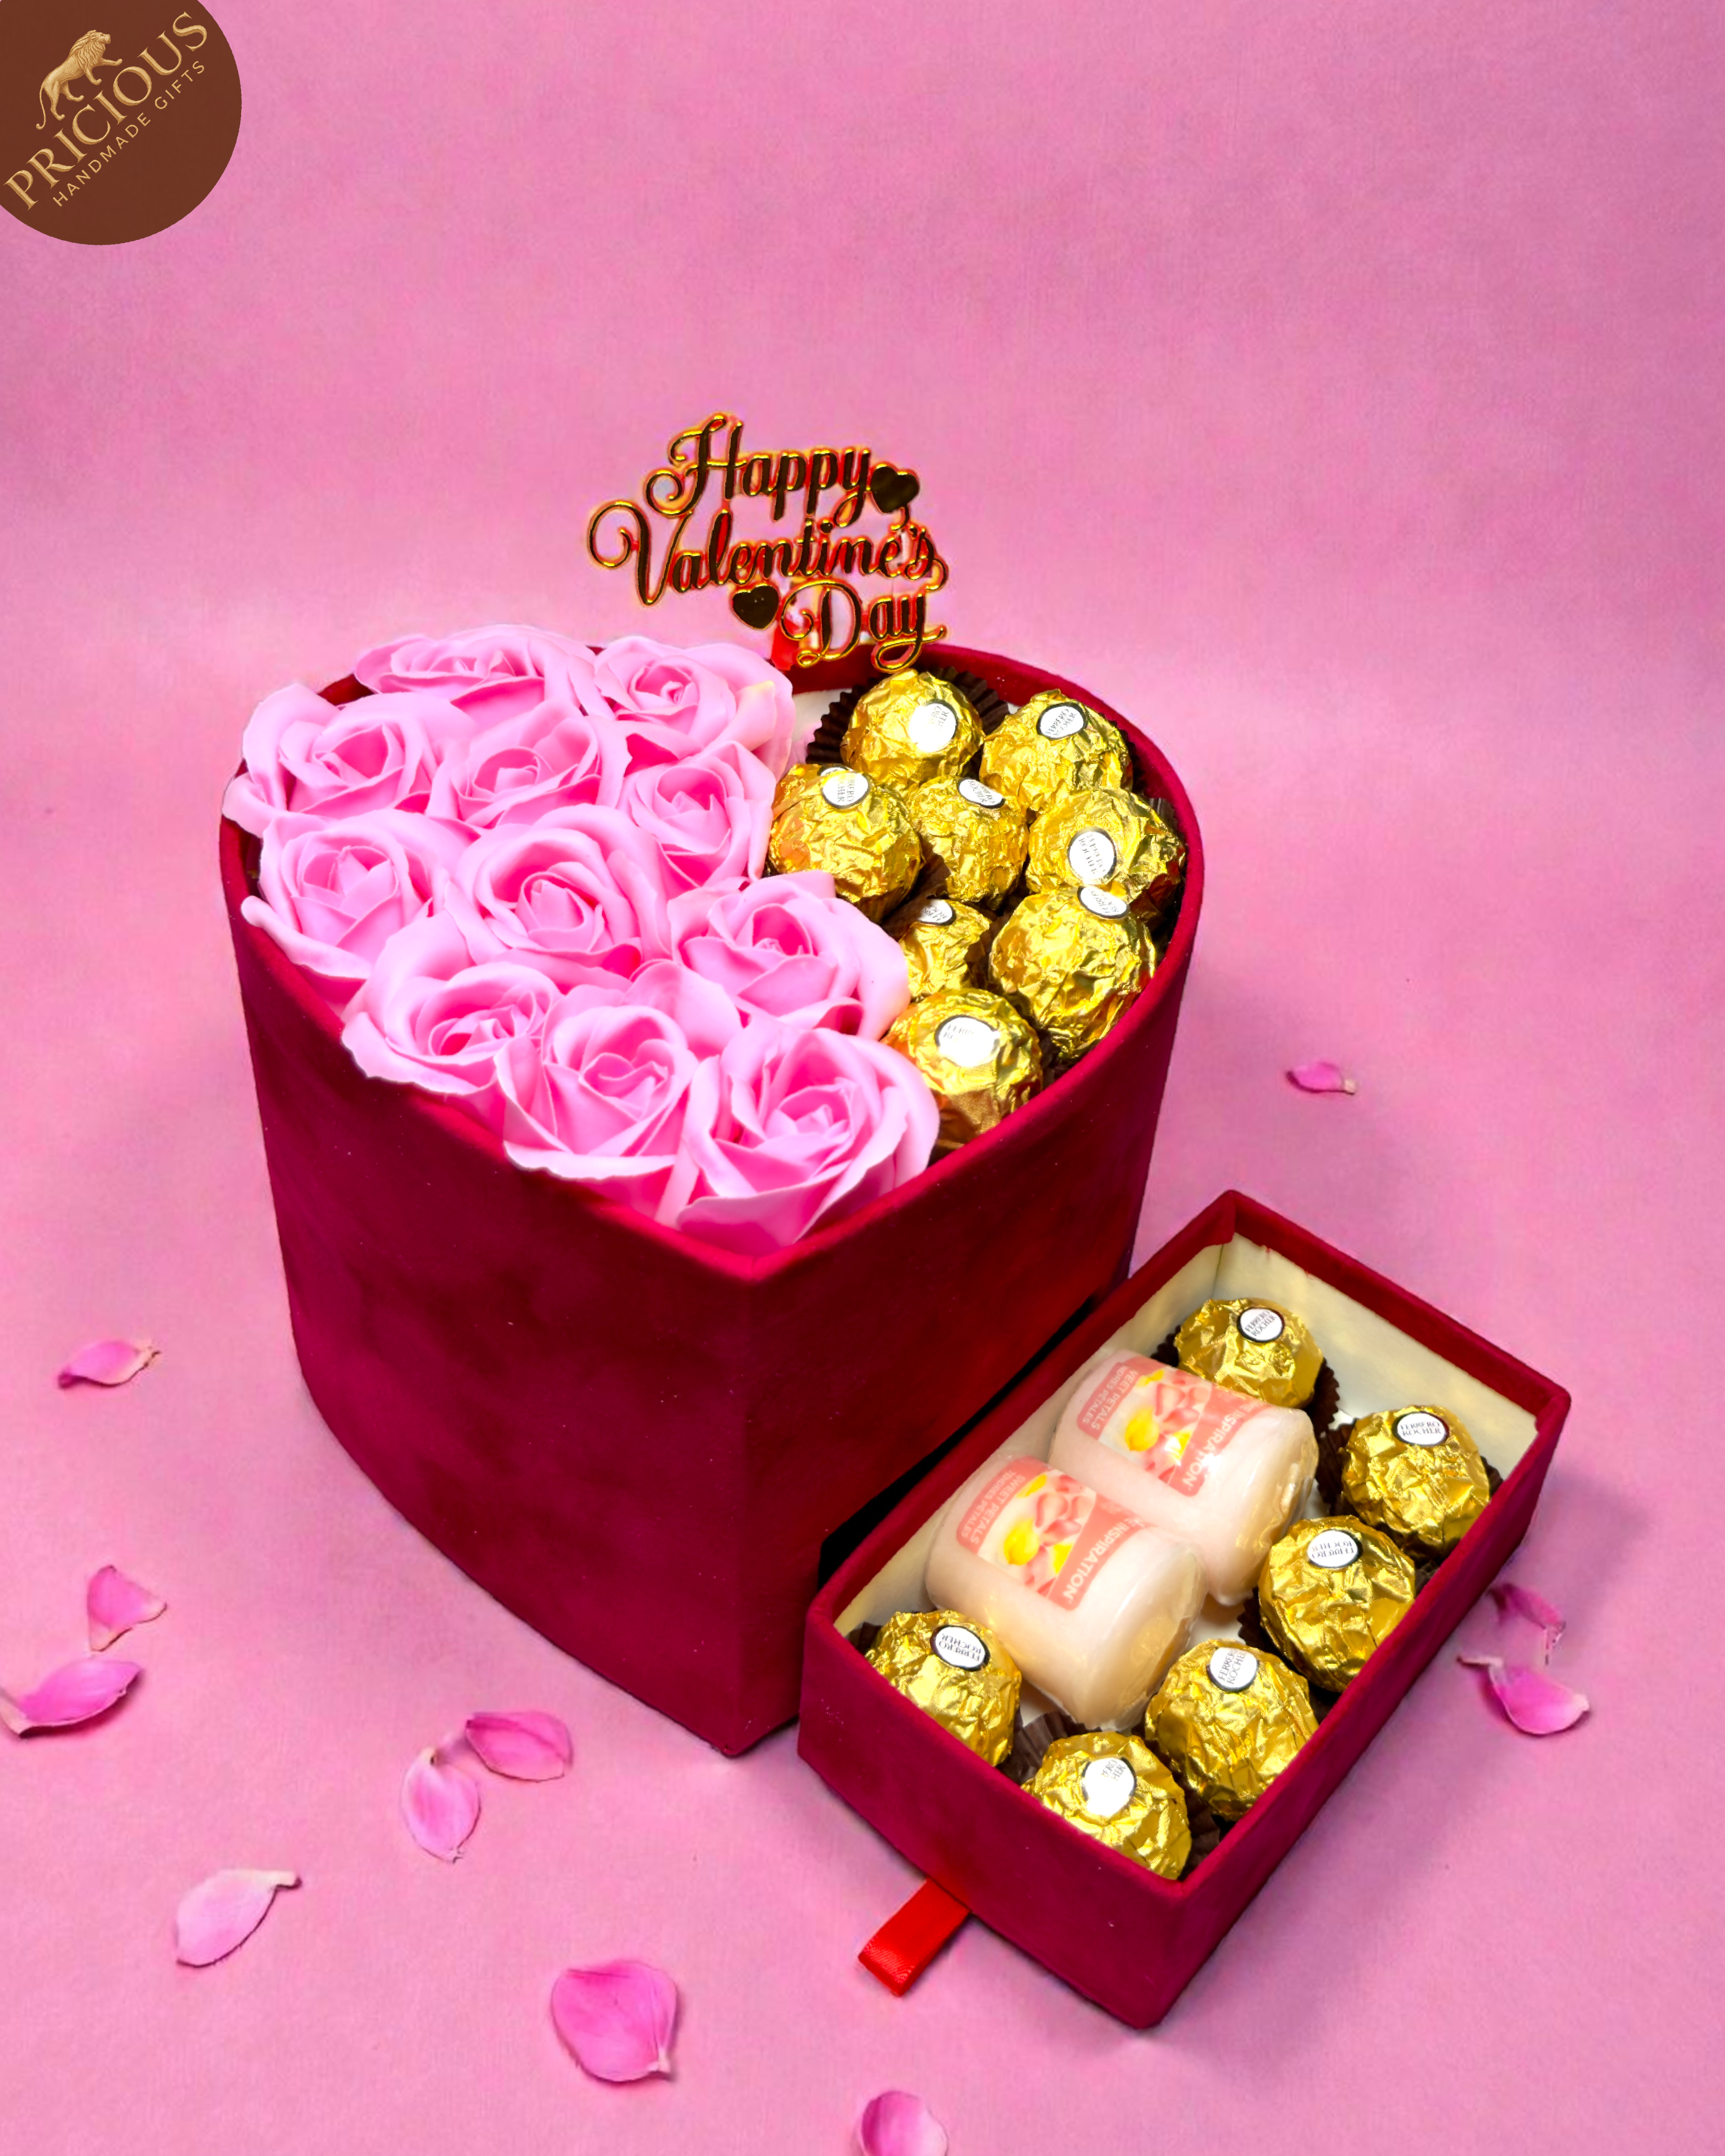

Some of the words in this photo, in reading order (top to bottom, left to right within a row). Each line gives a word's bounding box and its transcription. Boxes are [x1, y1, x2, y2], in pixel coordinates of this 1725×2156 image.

[645, 412, 872, 527] Happy
[588, 500, 949, 606] Valentine's
[779, 578, 948, 672] Day
[1091, 1392, 1121, 1430] PETALS
[997, 1474, 1026, 1503] SWEET
[972, 1503, 999, 1544] PETALS
[1063, 1521, 1130, 1599] INSPIRATION
[938, 1640, 980, 1661] FERRERO
[941, 1633, 981, 1654] ROCHER
